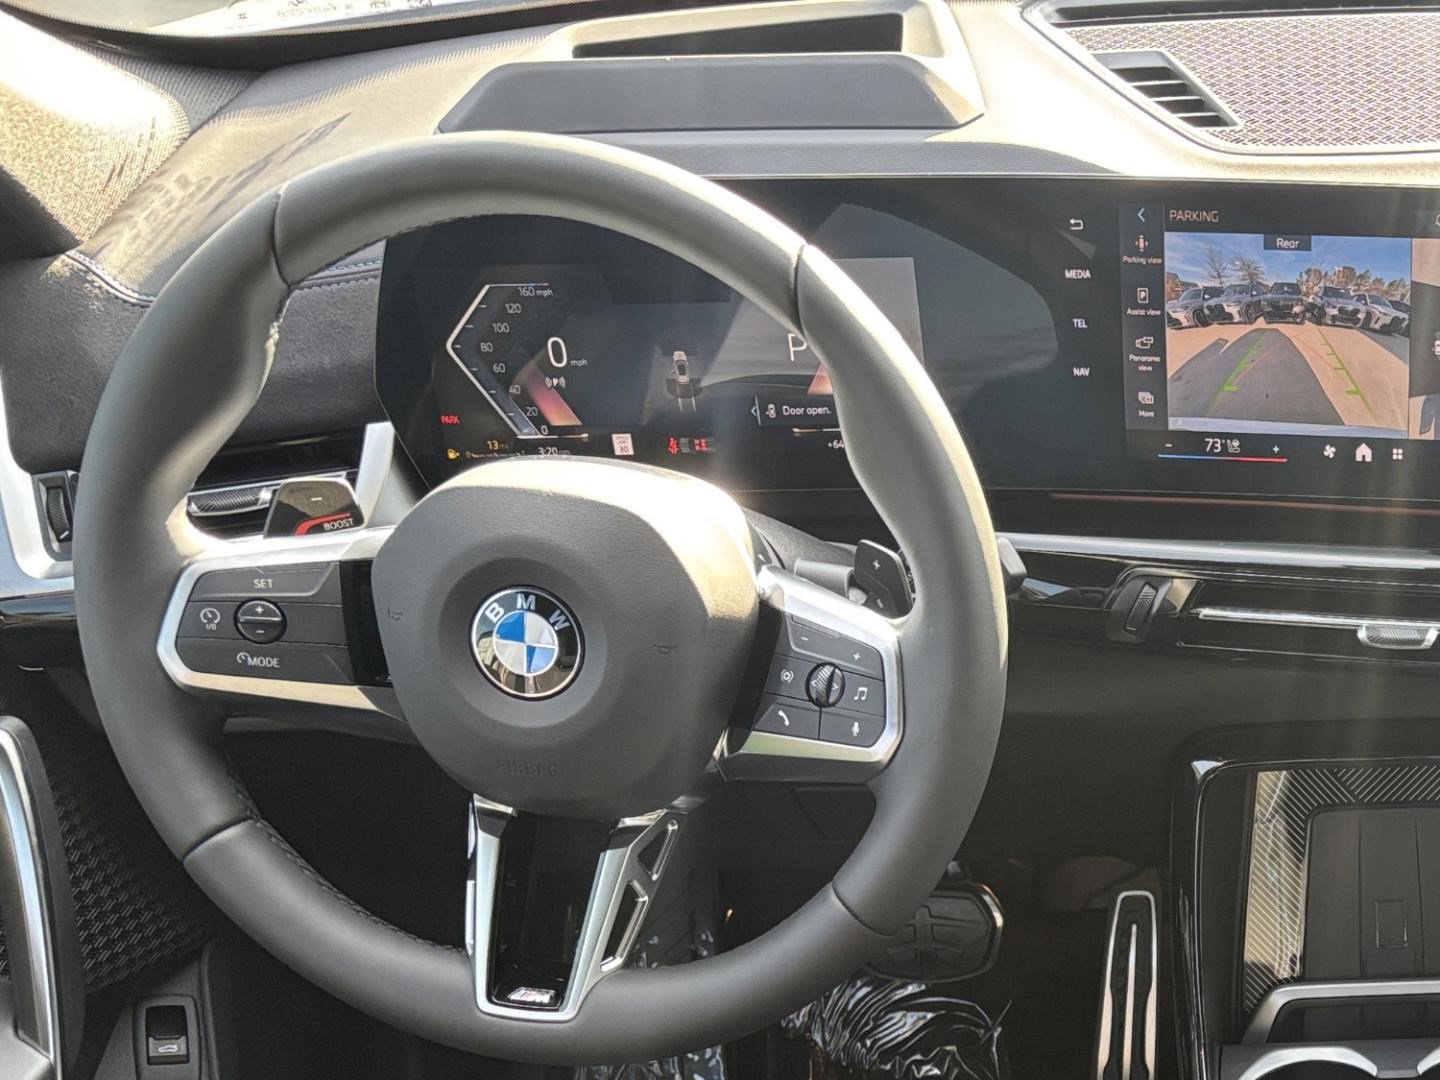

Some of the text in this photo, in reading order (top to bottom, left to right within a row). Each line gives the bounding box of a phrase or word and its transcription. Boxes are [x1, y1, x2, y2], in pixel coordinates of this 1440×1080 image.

[1168, 209, 1220, 223] PARKING
[1276, 237, 1300, 249] Rear
[1122, 255, 1163, 266] Parking view
[1064, 269, 1092, 280] MEDIA
[517, 286, 554, 298] 160 mph
[504, 302, 522, 314] 120
[1126, 307, 1162, 316] Assist view
[491, 322, 510, 333] 100
[1072, 318, 1088, 329] TEL
[480, 341, 494, 353] 80
[547, 336, 588, 368] 0 mph
[787, 333, 808, 362] P
[492, 362, 506, 374] 60
[1072, 367, 1091, 377] NAV
[1138, 364, 1153, 372] view
[508, 384, 521, 395] 40
[525, 406, 539, 418] 20
[782, 405, 804, 416] Door
[1138, 409, 1155, 418] More
[540, 424, 549, 436] 0
[486, 440, 499, 451] 13
[322, 518, 355, 532] BOOST
[253, 578, 273, 590] SET
[485, 593, 570, 631] BMW
[248, 657, 281, 669] MODE
